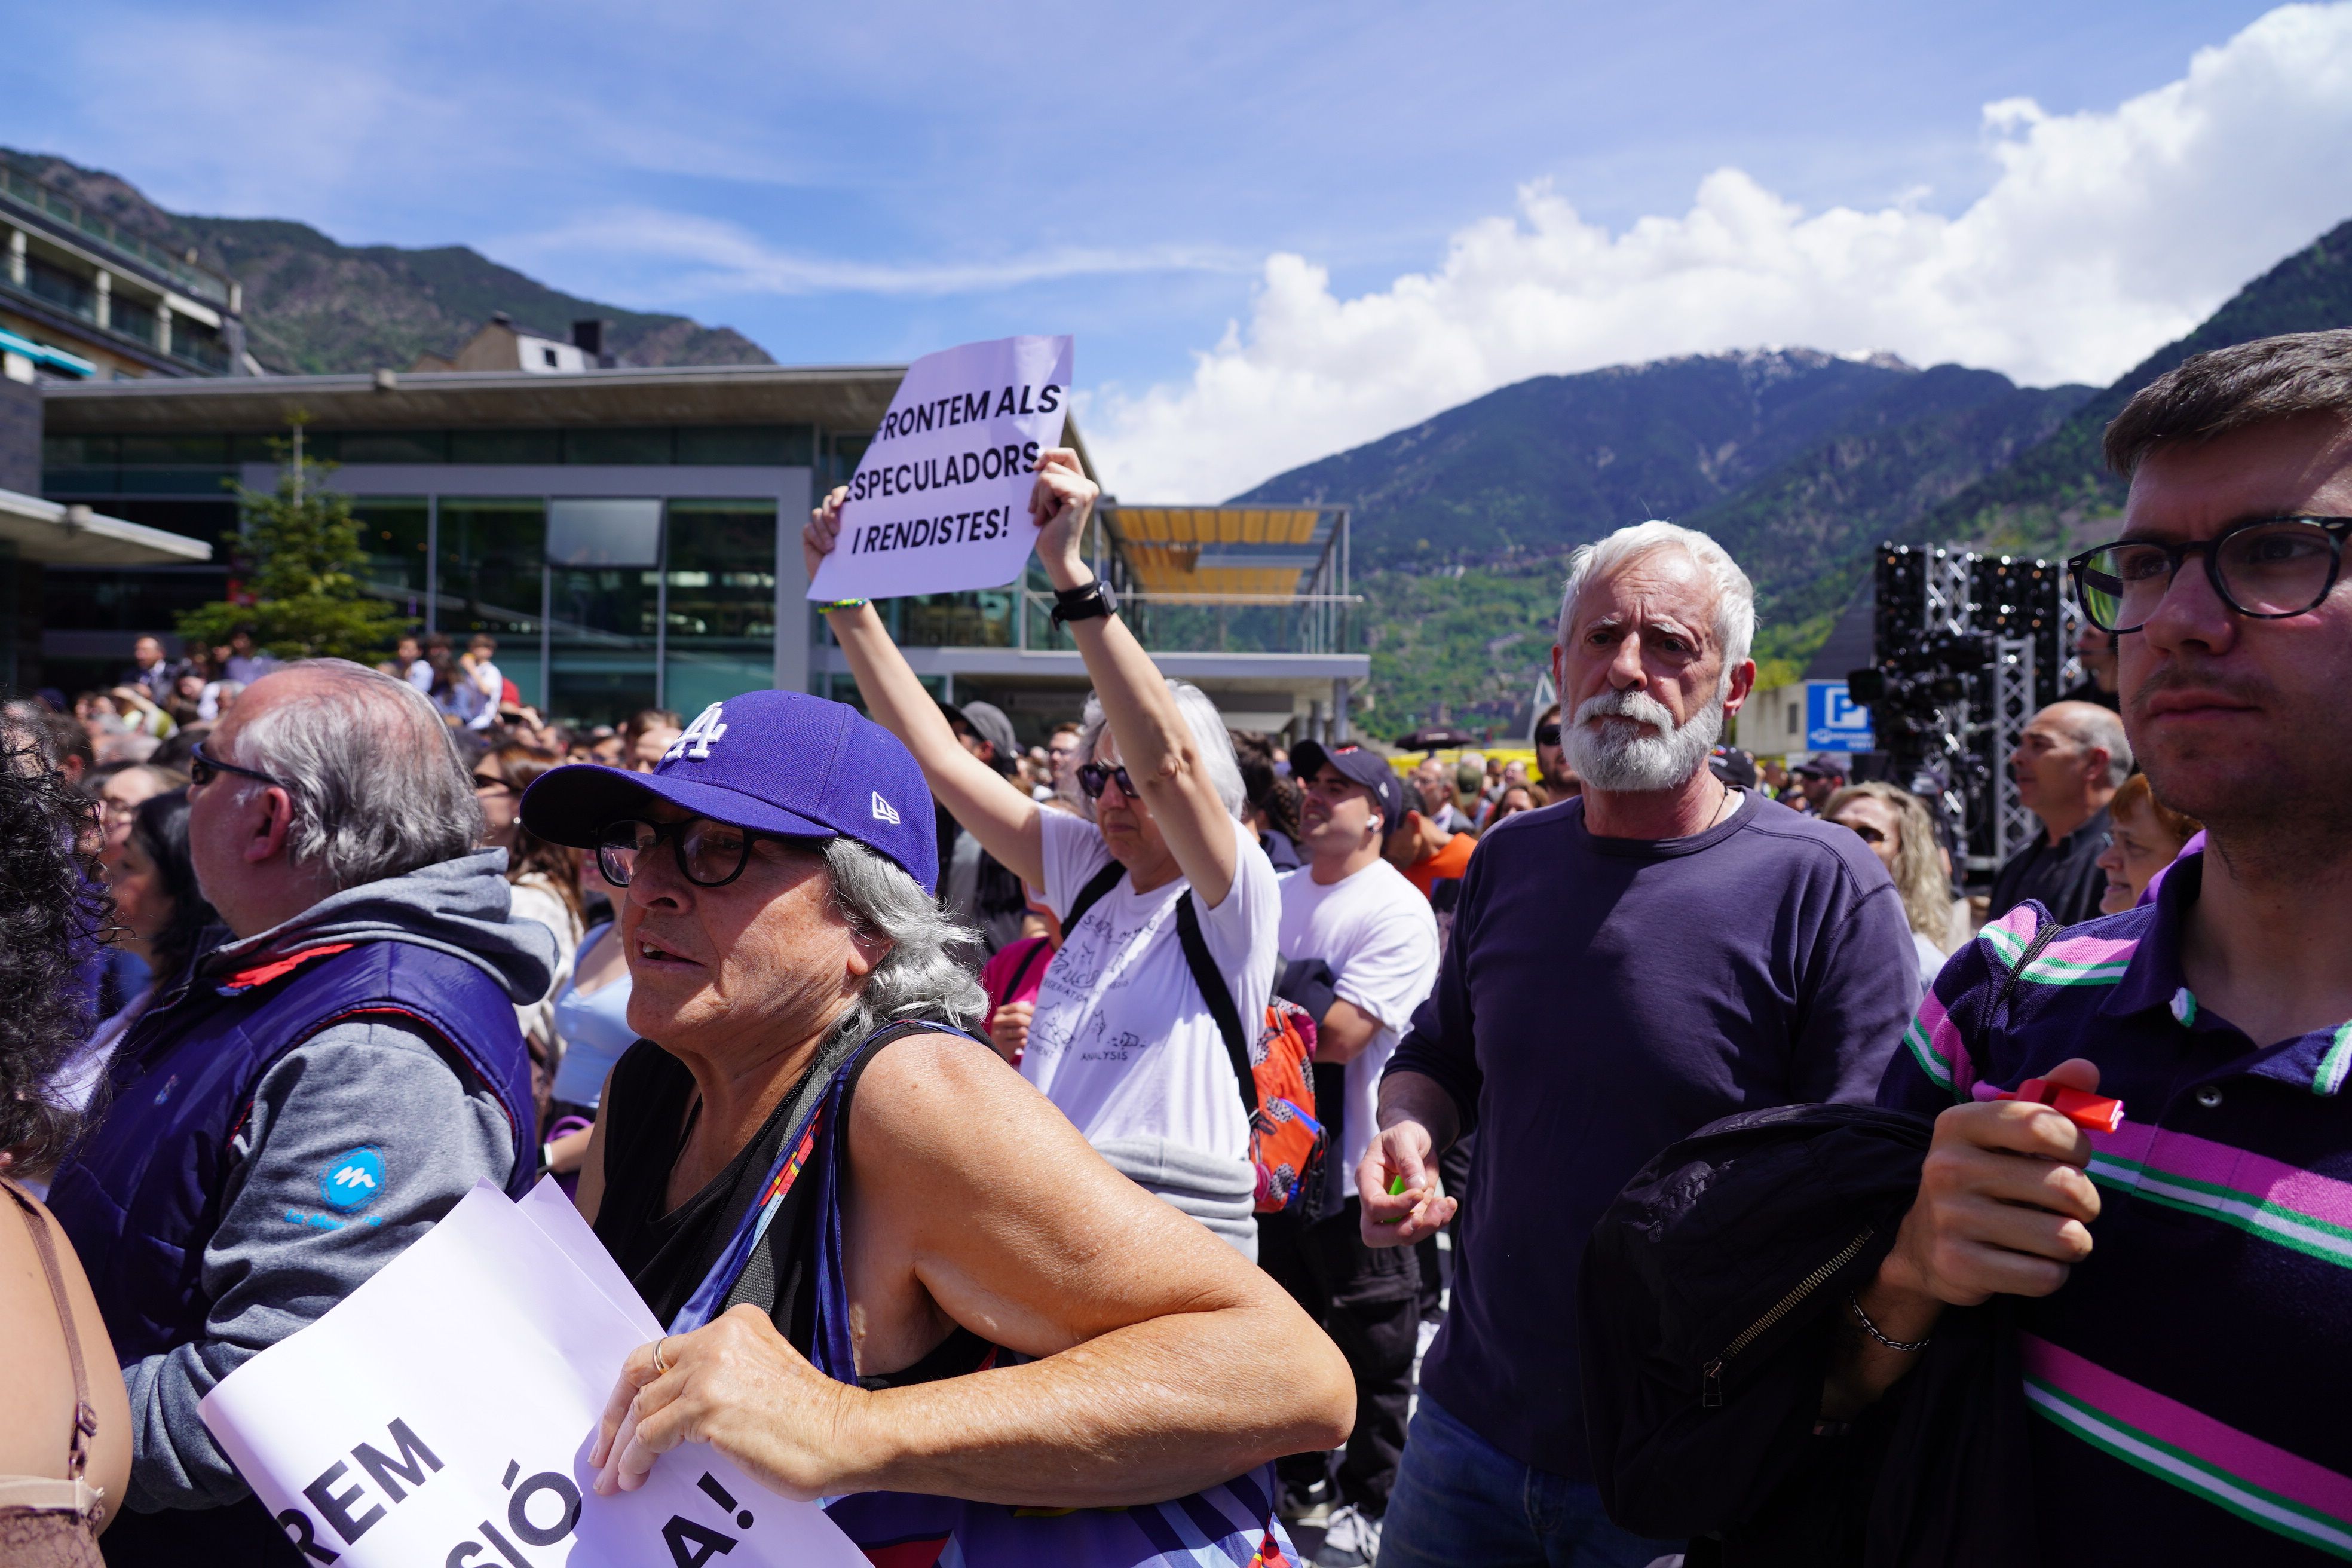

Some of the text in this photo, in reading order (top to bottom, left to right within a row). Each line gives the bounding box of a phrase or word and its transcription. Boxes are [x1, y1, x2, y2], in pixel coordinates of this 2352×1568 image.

[995, 384, 1061, 418] ALS
[852, 506, 1010, 555] I RENDISTES!
[1080, 1051, 1128, 1061] ANALYSIS
